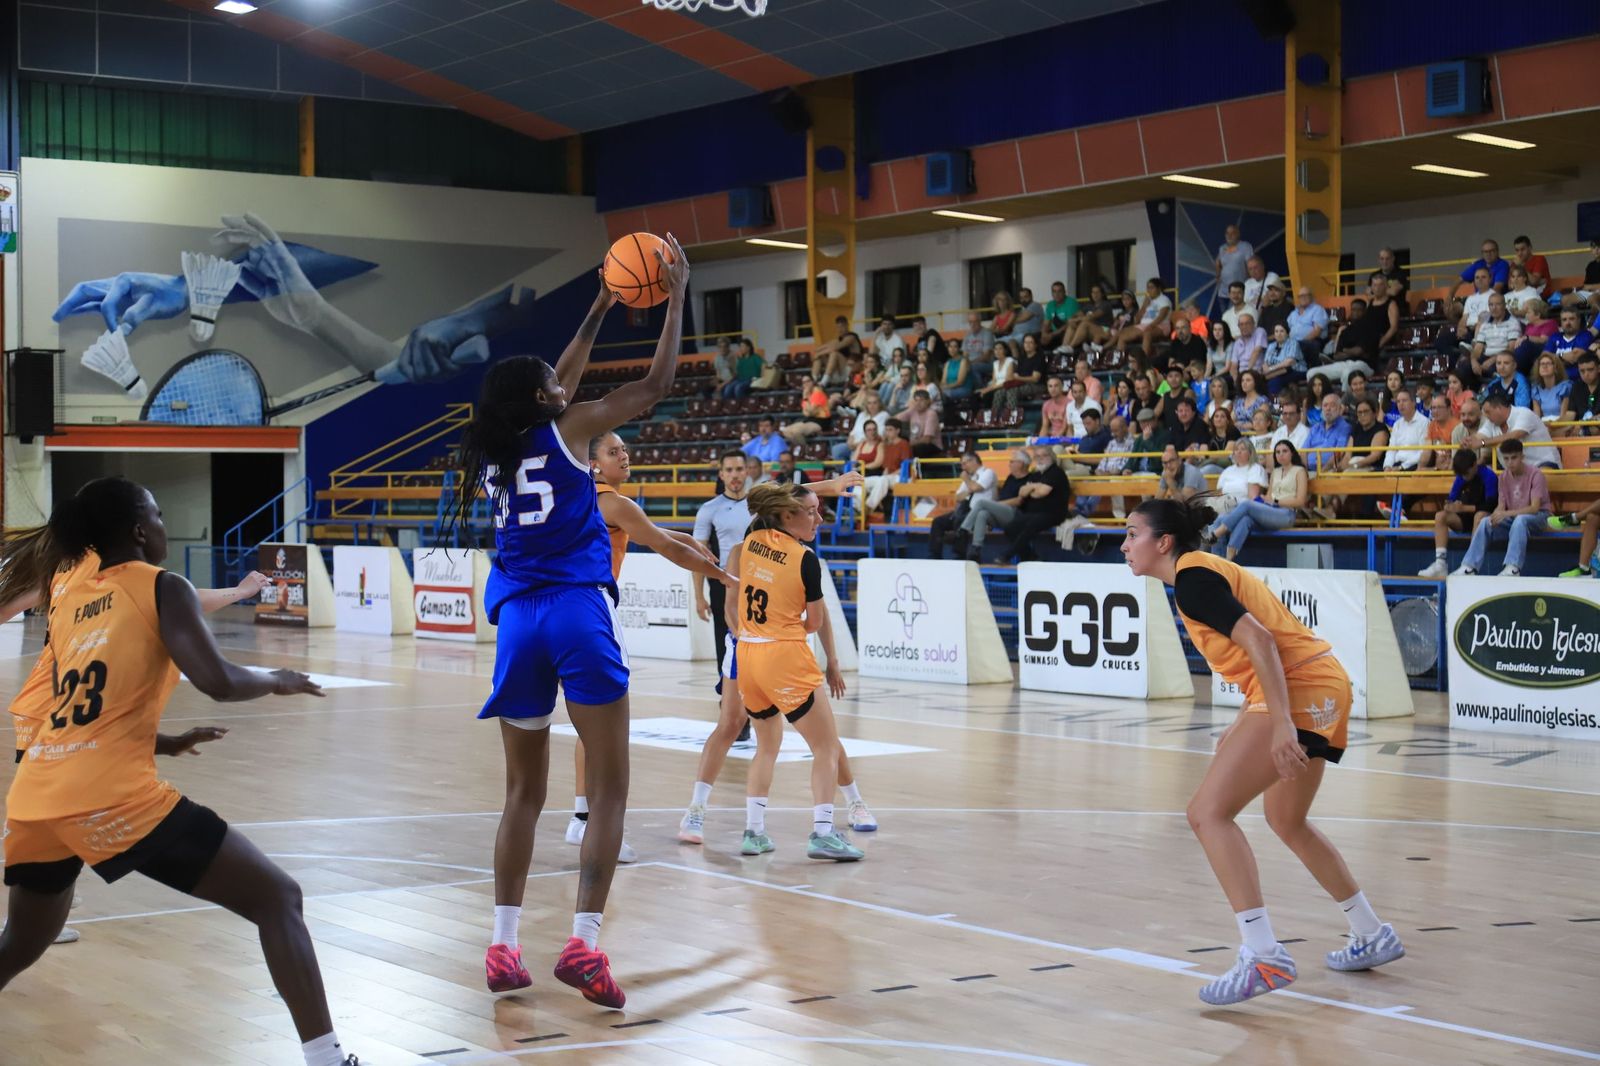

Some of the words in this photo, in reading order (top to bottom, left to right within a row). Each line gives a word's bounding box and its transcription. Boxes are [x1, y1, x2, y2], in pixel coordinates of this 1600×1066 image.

[423, 561, 462, 582] Muebles
[74, 590, 115, 625] F.POUYE
[420, 595, 453, 618] Gamazo
[454, 598, 466, 618] 22
[744, 584, 769, 626] 13
[1024, 590, 1140, 668] G3C
[1470, 613, 1543, 656] Paulino
[864, 640, 920, 661] recoletas
[923, 642, 958, 663] salud
[1024, 654, 1059, 667] GIMNASIO
[1102, 659, 1140, 671] CRUCES
[1495, 661, 1540, 674] Embutidos
[1541, 665, 1547, 676] y
[1547, 664, 1585, 677] Jamones
[50, 659, 108, 731] 23
[1456, 702, 1600, 730] www.paulinoiglesias.
